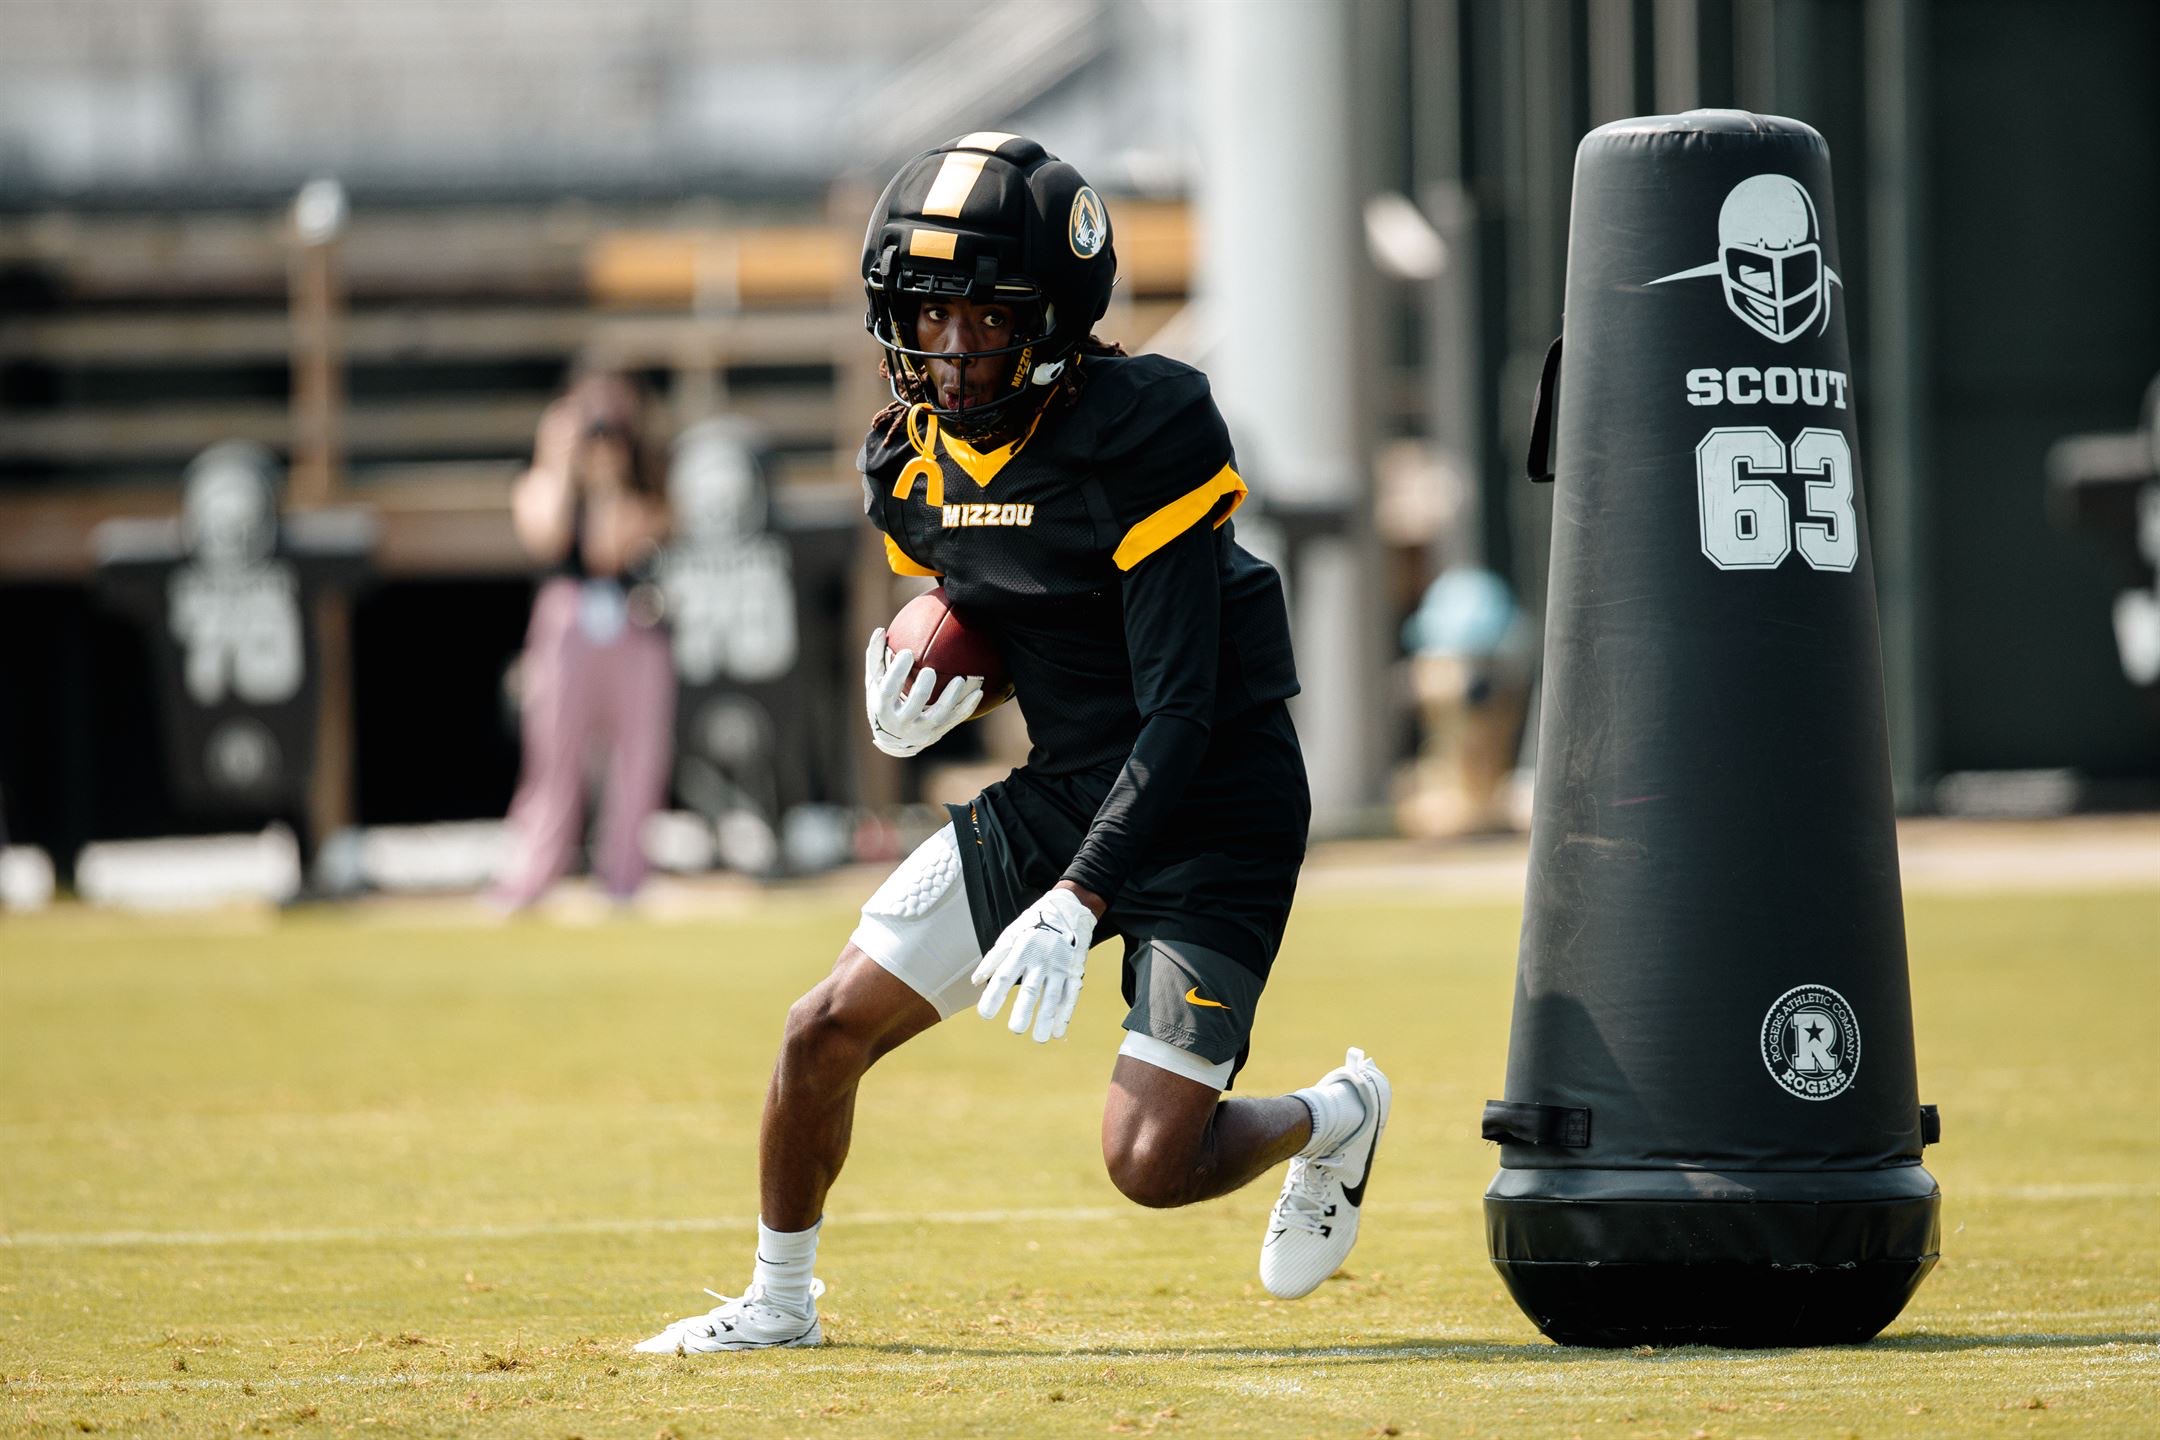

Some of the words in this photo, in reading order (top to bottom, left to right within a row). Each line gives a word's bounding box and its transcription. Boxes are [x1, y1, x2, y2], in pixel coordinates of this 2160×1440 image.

[1011, 339, 1032, 388] MIZZO
[1685, 366, 1848, 410] SCOUT
[941, 503, 1035, 528] MIZZOU
[1695, 425, 1859, 573] 63
[1769, 1012, 1786, 1063] ROGERS
[1782, 992, 1833, 1016] ATHLETIC
[1832, 1002, 1856, 1064] COMPANY
[1791, 1010, 1838, 1072] R
[1781, 1068, 1847, 1094] ROGERS
